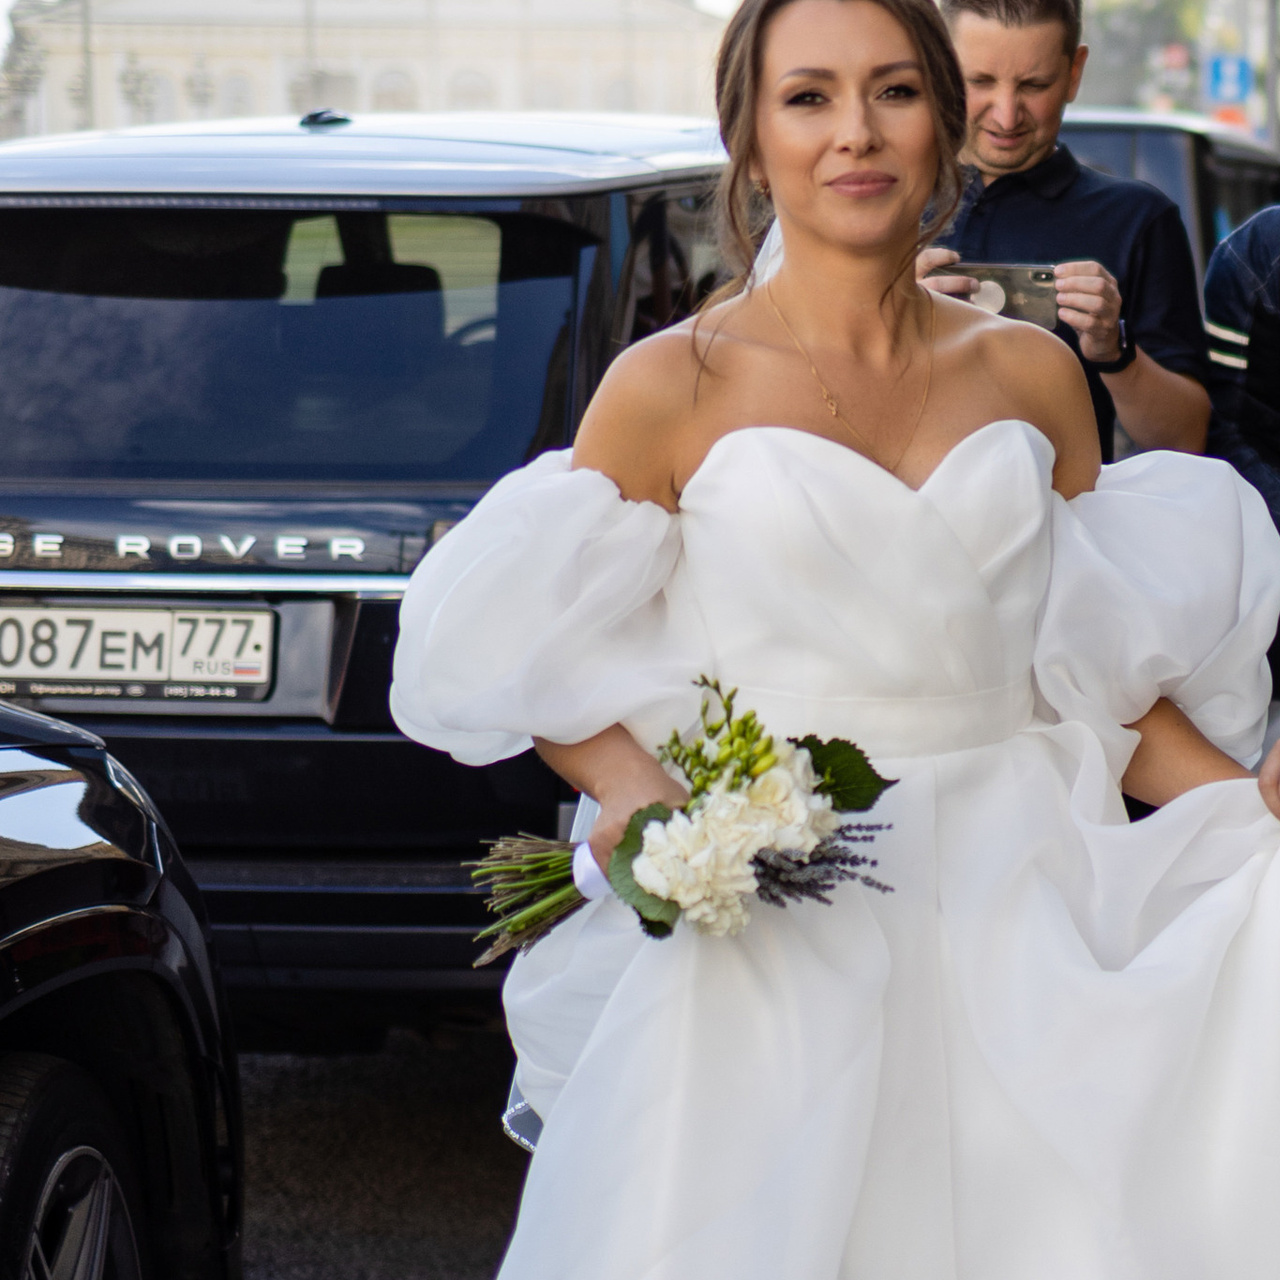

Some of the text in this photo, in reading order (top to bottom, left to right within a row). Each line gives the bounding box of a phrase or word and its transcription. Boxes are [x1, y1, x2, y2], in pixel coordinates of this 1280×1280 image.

[117, 534, 365, 561] ROVER
[178, 618, 254, 657] 777
[193, 661, 231, 675] RUS
